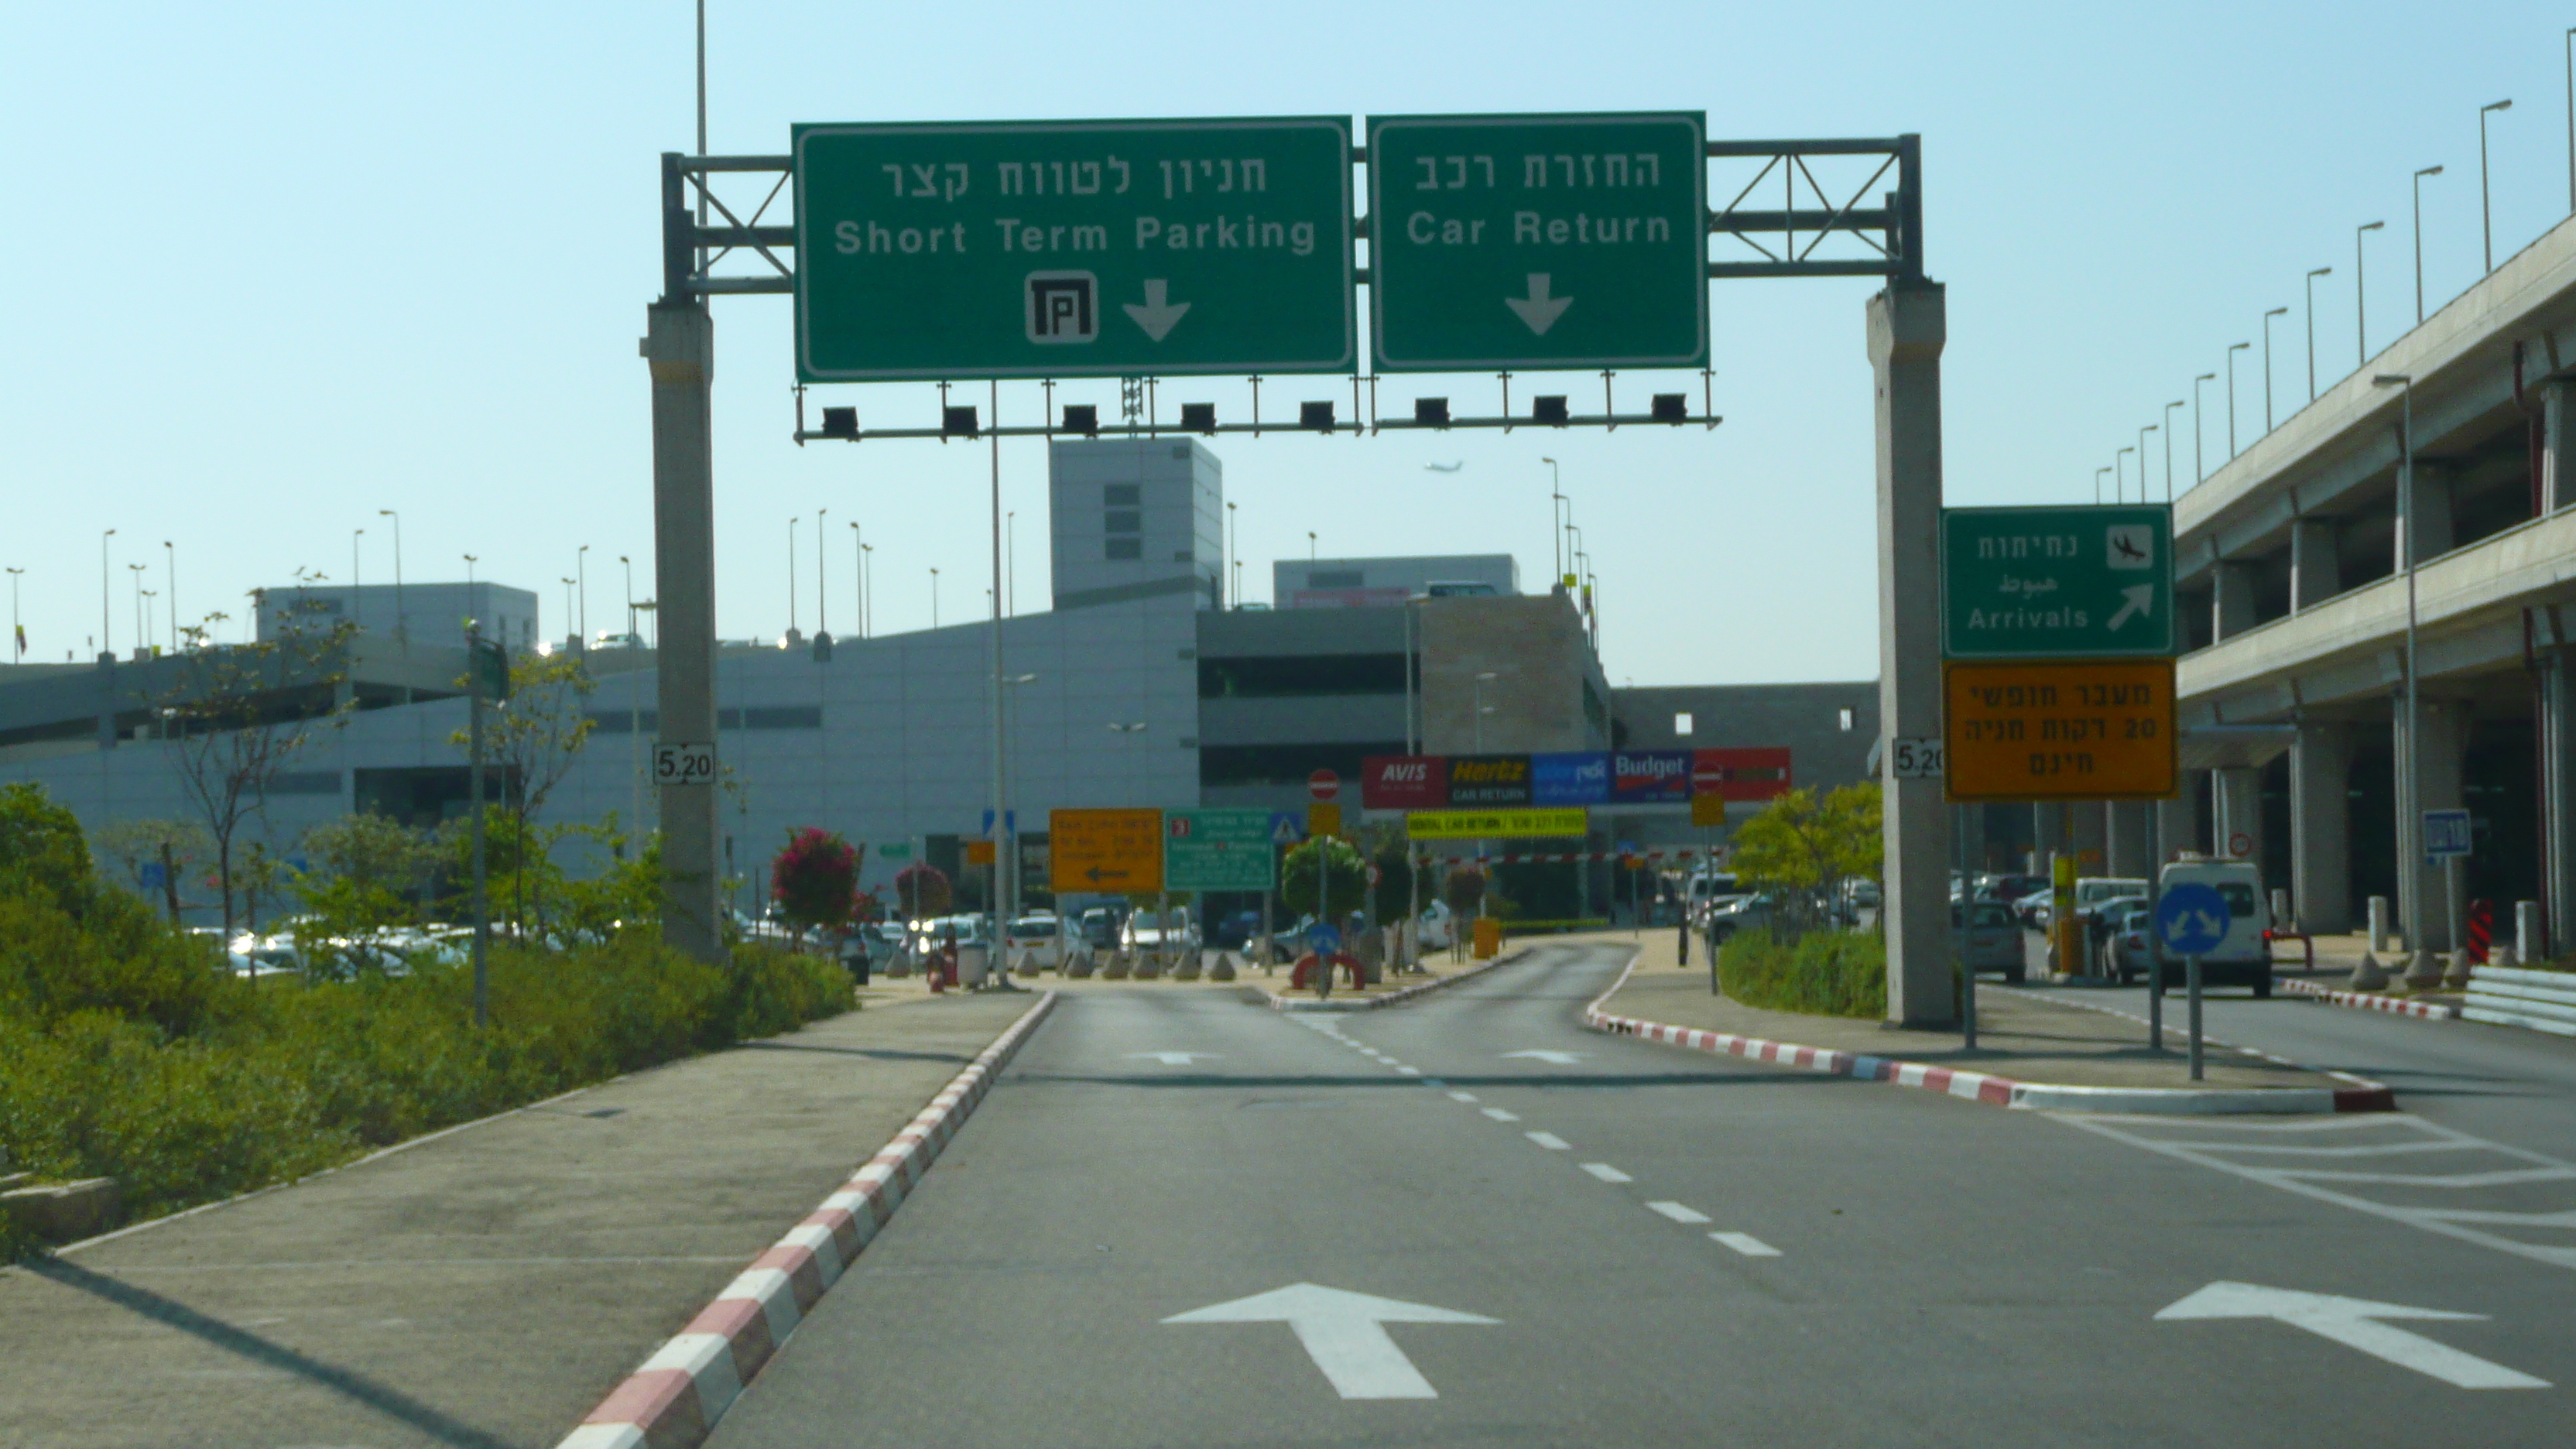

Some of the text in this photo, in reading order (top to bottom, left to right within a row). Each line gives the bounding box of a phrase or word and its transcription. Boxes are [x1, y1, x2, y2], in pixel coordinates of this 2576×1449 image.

[882, 156, 1266, 202] חניון לטווח קצר
[1416, 154, 1660, 190] החזרת רכב
[835, 215, 1314, 256] Short Term Parking
[1407, 211, 1670, 245] Car Return
[1979, 536, 2078, 558] נחיתות
[1968, 607, 2088, 629] Arrivals
[1969, 683, 2151, 708] מעבר חופשי
[1966, 717, 2157, 743] 20 דקות חניה
[659, 750, 711, 776] 5.20
[1382, 763, 1427, 781] AVIS
[1453, 760, 1526, 782] Hertz
[1615, 755, 1684, 779] Budget
[2029, 753, 2093, 776] חינם
[1453, 789, 1476, 801] CAR
[1479, 787, 1526, 800] RETURN
